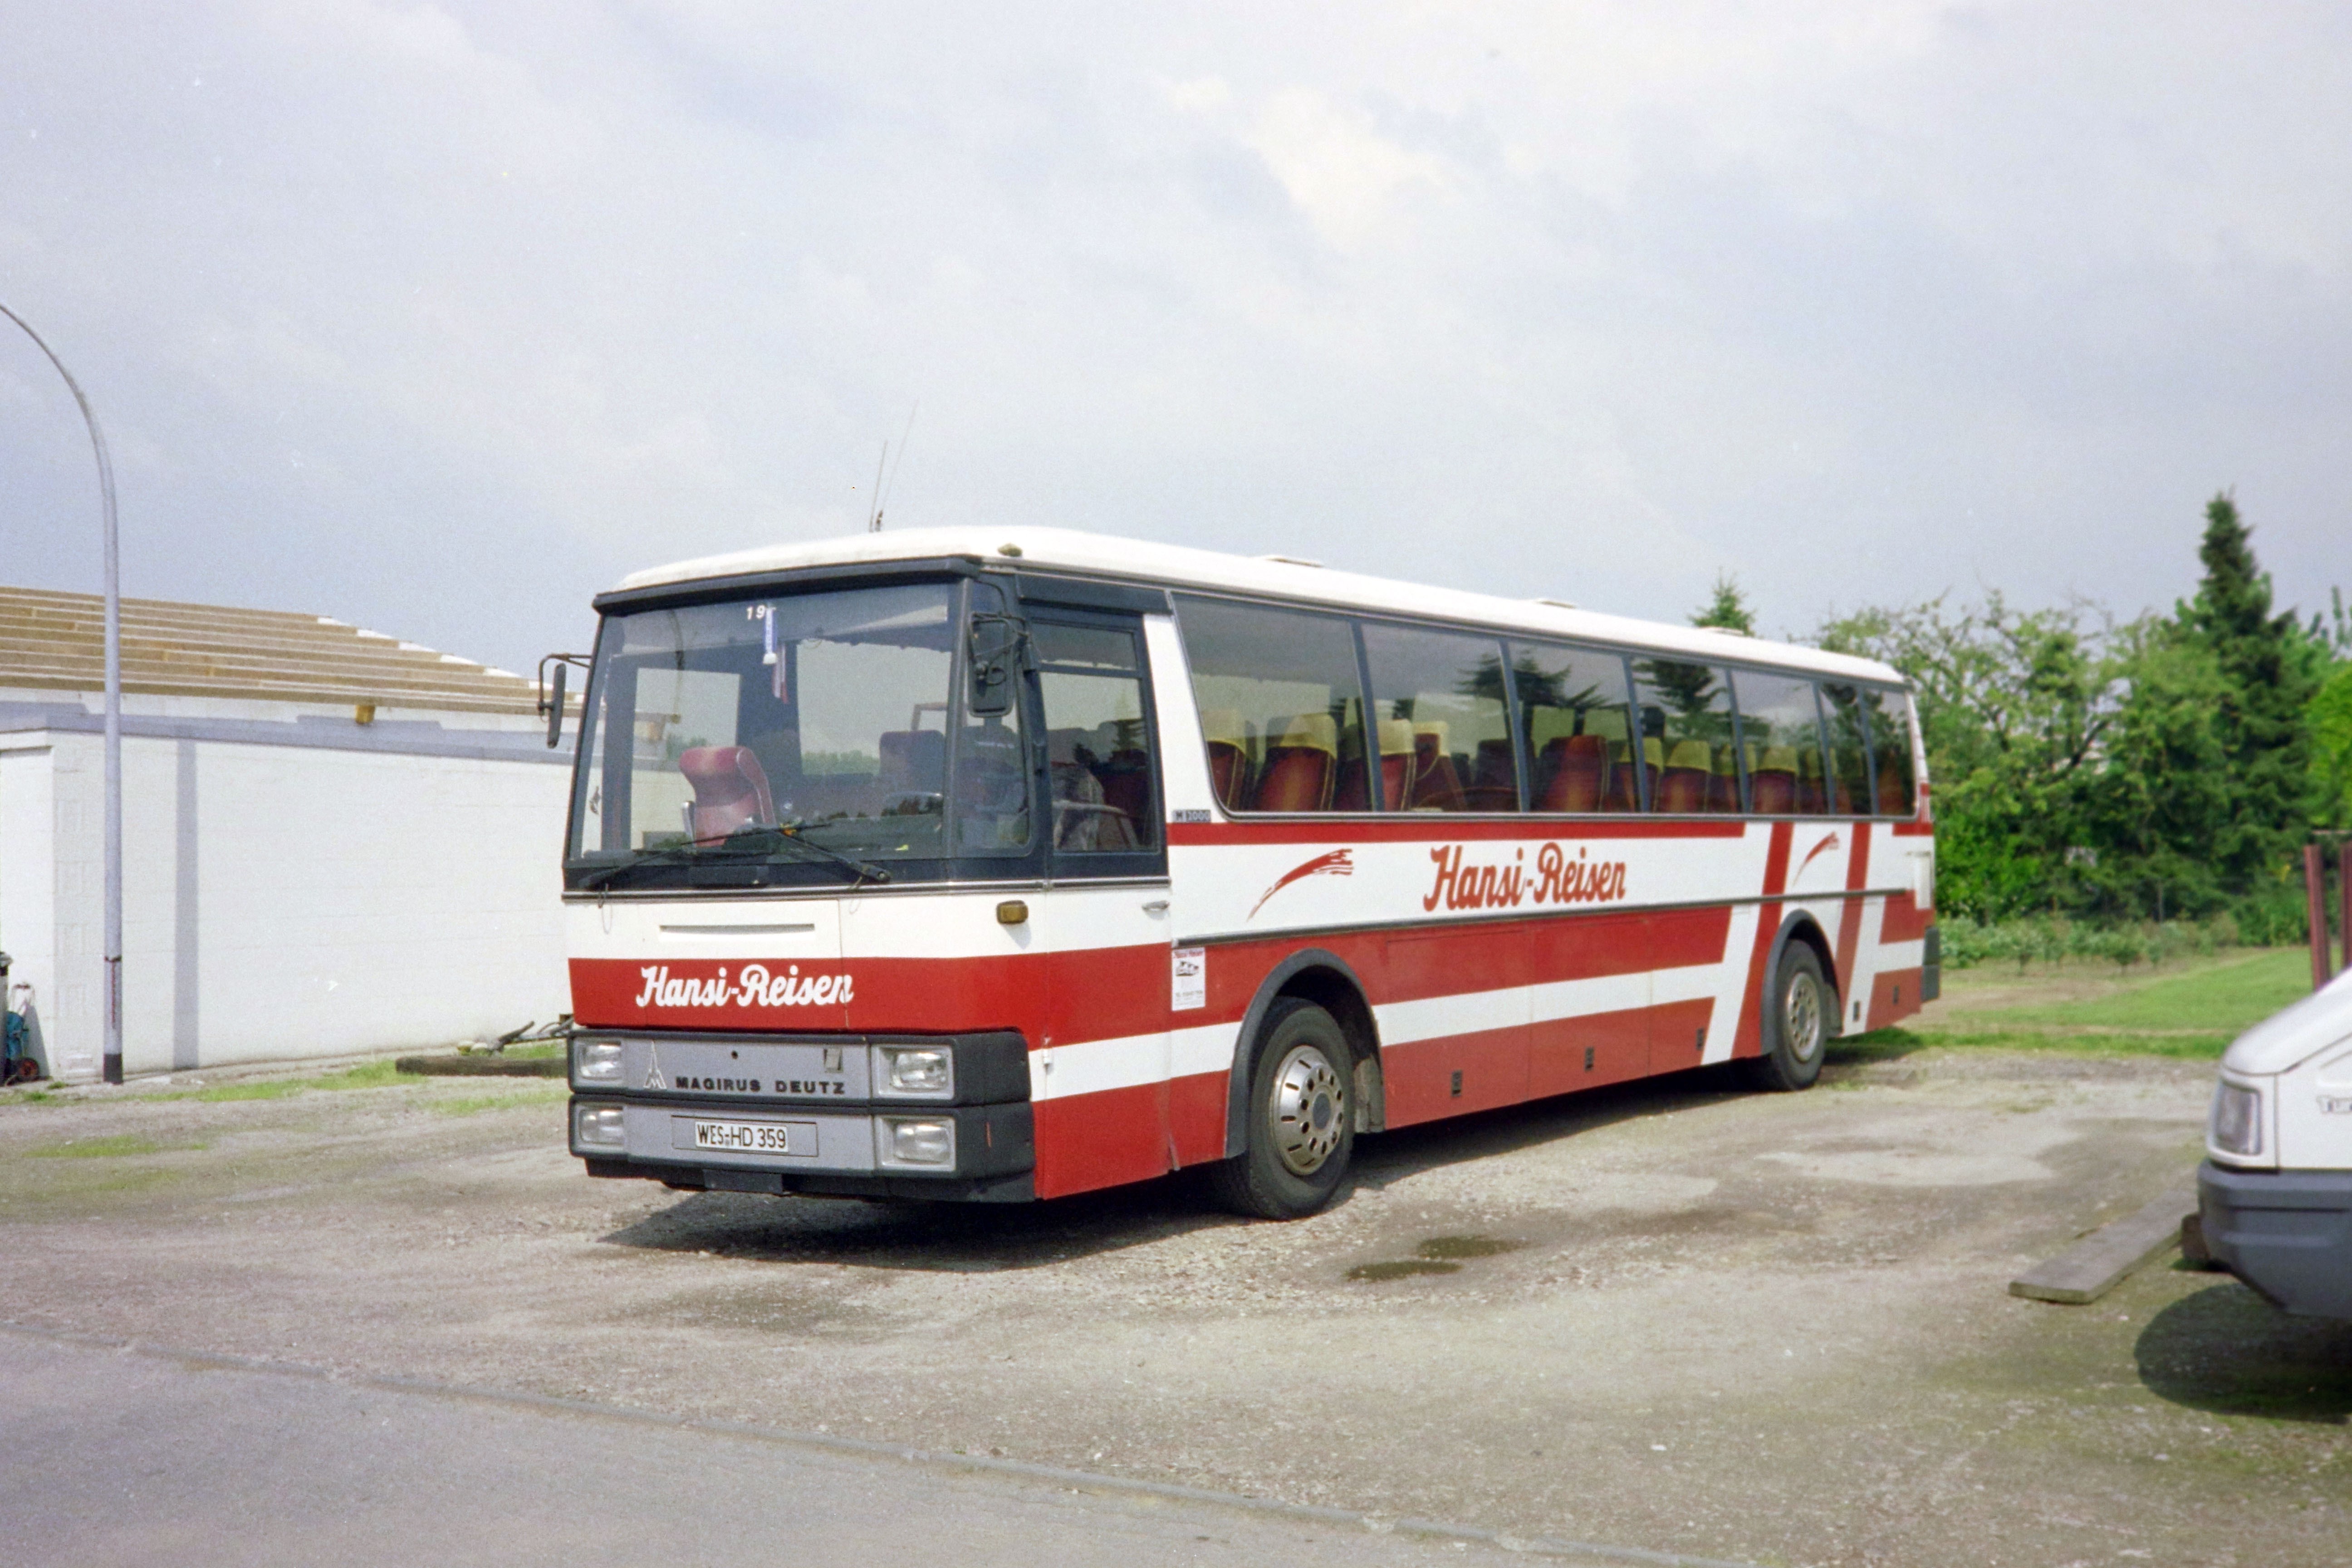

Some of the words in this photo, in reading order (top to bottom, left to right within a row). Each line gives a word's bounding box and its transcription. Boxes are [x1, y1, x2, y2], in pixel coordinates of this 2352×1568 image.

[1423, 842, 1626, 911] Hansi-Reisen
[636, 964, 853, 1007] Hansi-Reisen
[676, 1077, 761, 1092] MAGIRUS
[775, 1080, 845, 1094] DEUTZ
[757, 1128, 786, 1148] 359
